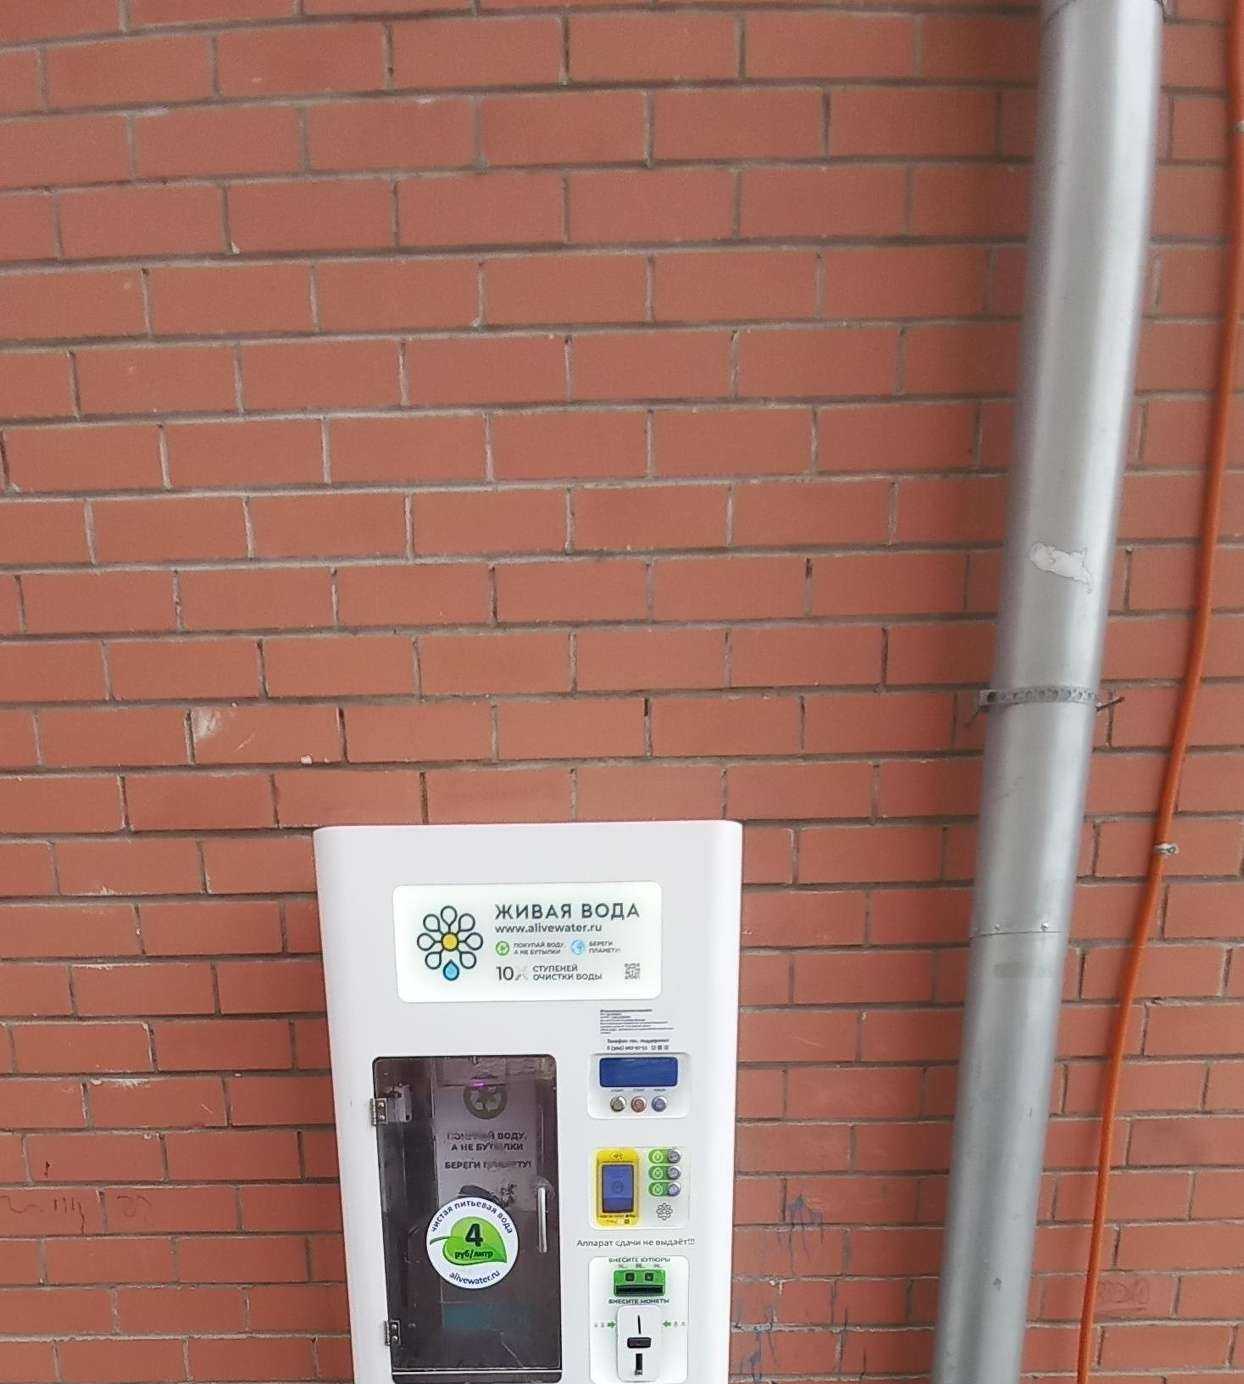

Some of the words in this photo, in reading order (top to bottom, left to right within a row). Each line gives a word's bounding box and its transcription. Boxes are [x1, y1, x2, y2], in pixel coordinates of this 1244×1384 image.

[494, 903, 572, 920] ЖИВАЯ
[581, 902, 640, 921] ВОДА
[495, 923, 602, 933] www.alivewater.ru
[532, 964, 578, 972] СТУПЕНЕЙ
[496, 966, 514, 981] 10
[532, 973, 574, 981] ОЧИСТКИ
[576, 973, 602, 981] ВОДЫ
[451, 1143, 458, 1151] А
[460, 1143, 474, 1151] НЕ
[444, 1160, 481, 1170] БЕРЕГИ
[431, 1206, 454, 1232] чистая
[454, 1200, 497, 1214] питьевая
[497, 1213, 513, 1233] вода
[465, 1223, 484, 1247] 4
[576, 1239, 613, 1248] Аппарат
[615, 1240, 640, 1248] сдачи
[454, 1249, 494, 1259] руб/литр
[449, 1270, 500, 1285] alivewater.ru
